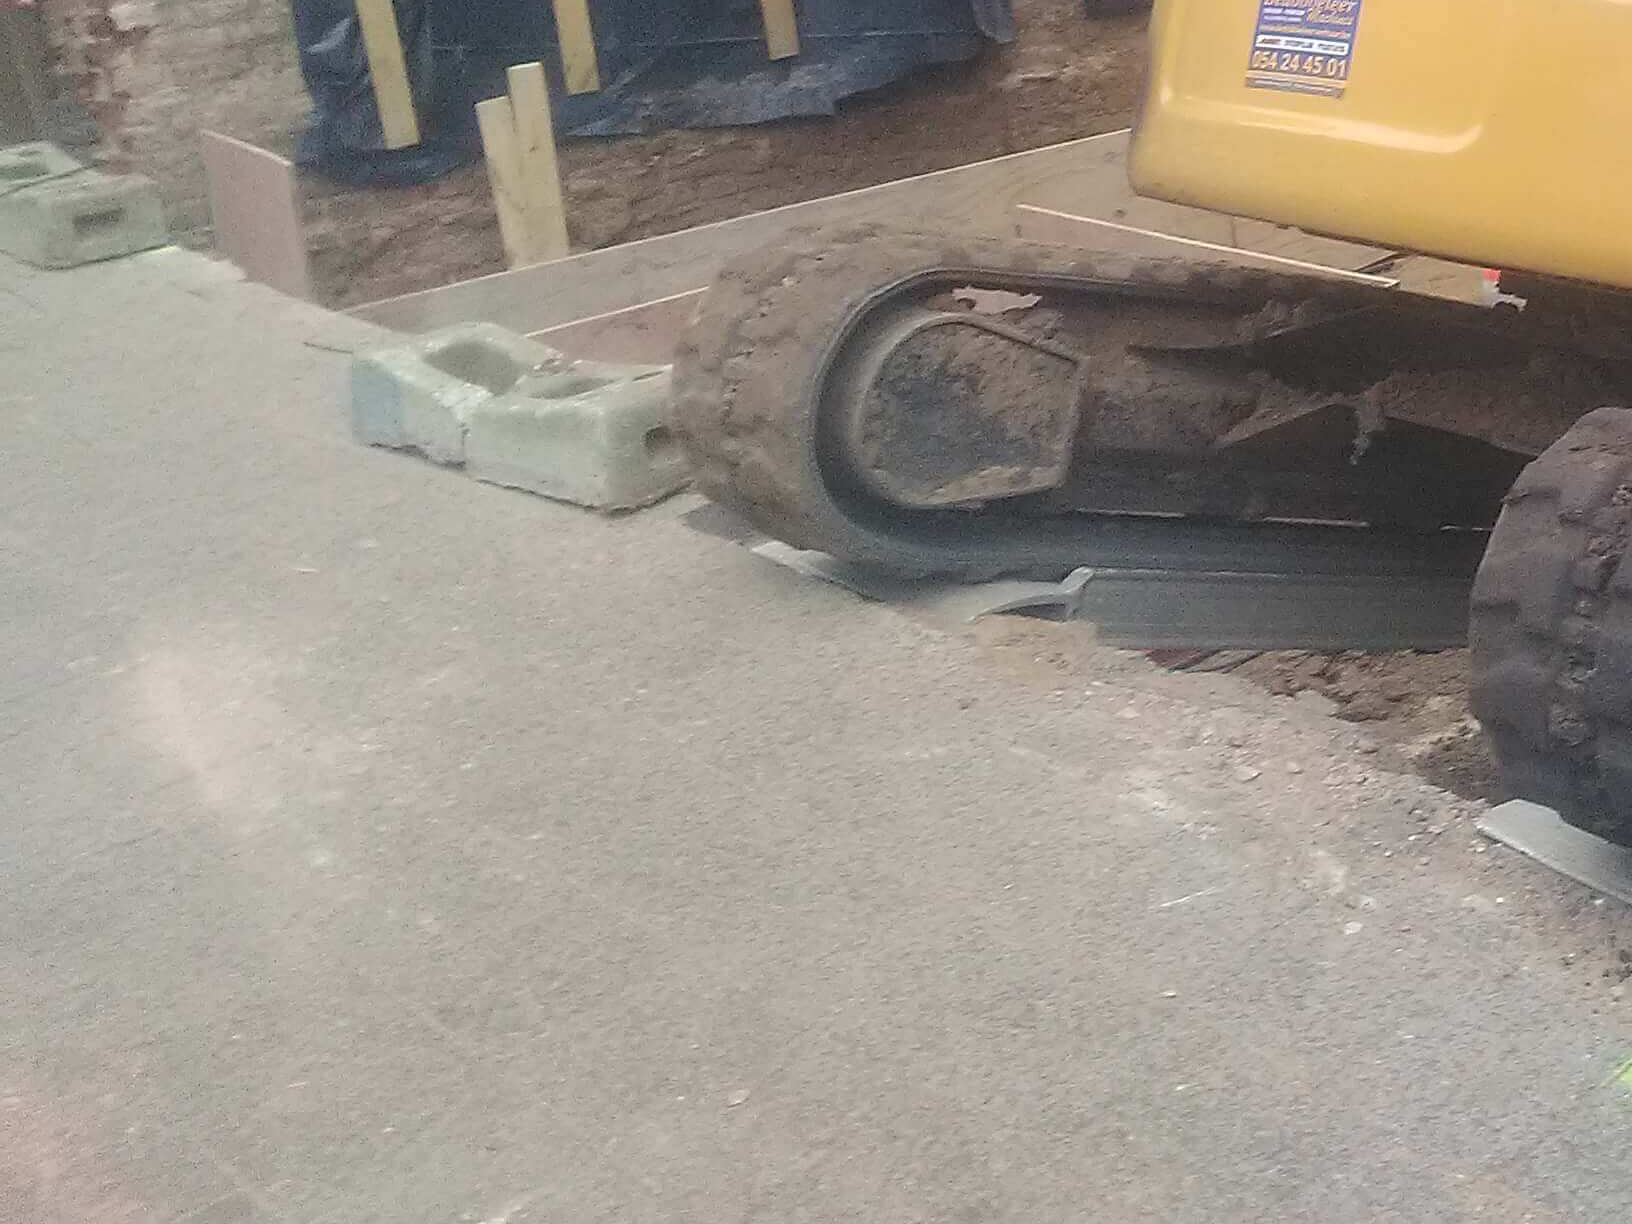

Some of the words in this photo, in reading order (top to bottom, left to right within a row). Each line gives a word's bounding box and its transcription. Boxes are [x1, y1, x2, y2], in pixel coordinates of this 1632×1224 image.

[1252, 50, 1279, 69] 054
[1280, 53, 1300, 72] 24
[1302, 55, 1325, 76] 45
[1327, 58, 1348, 78] 01
